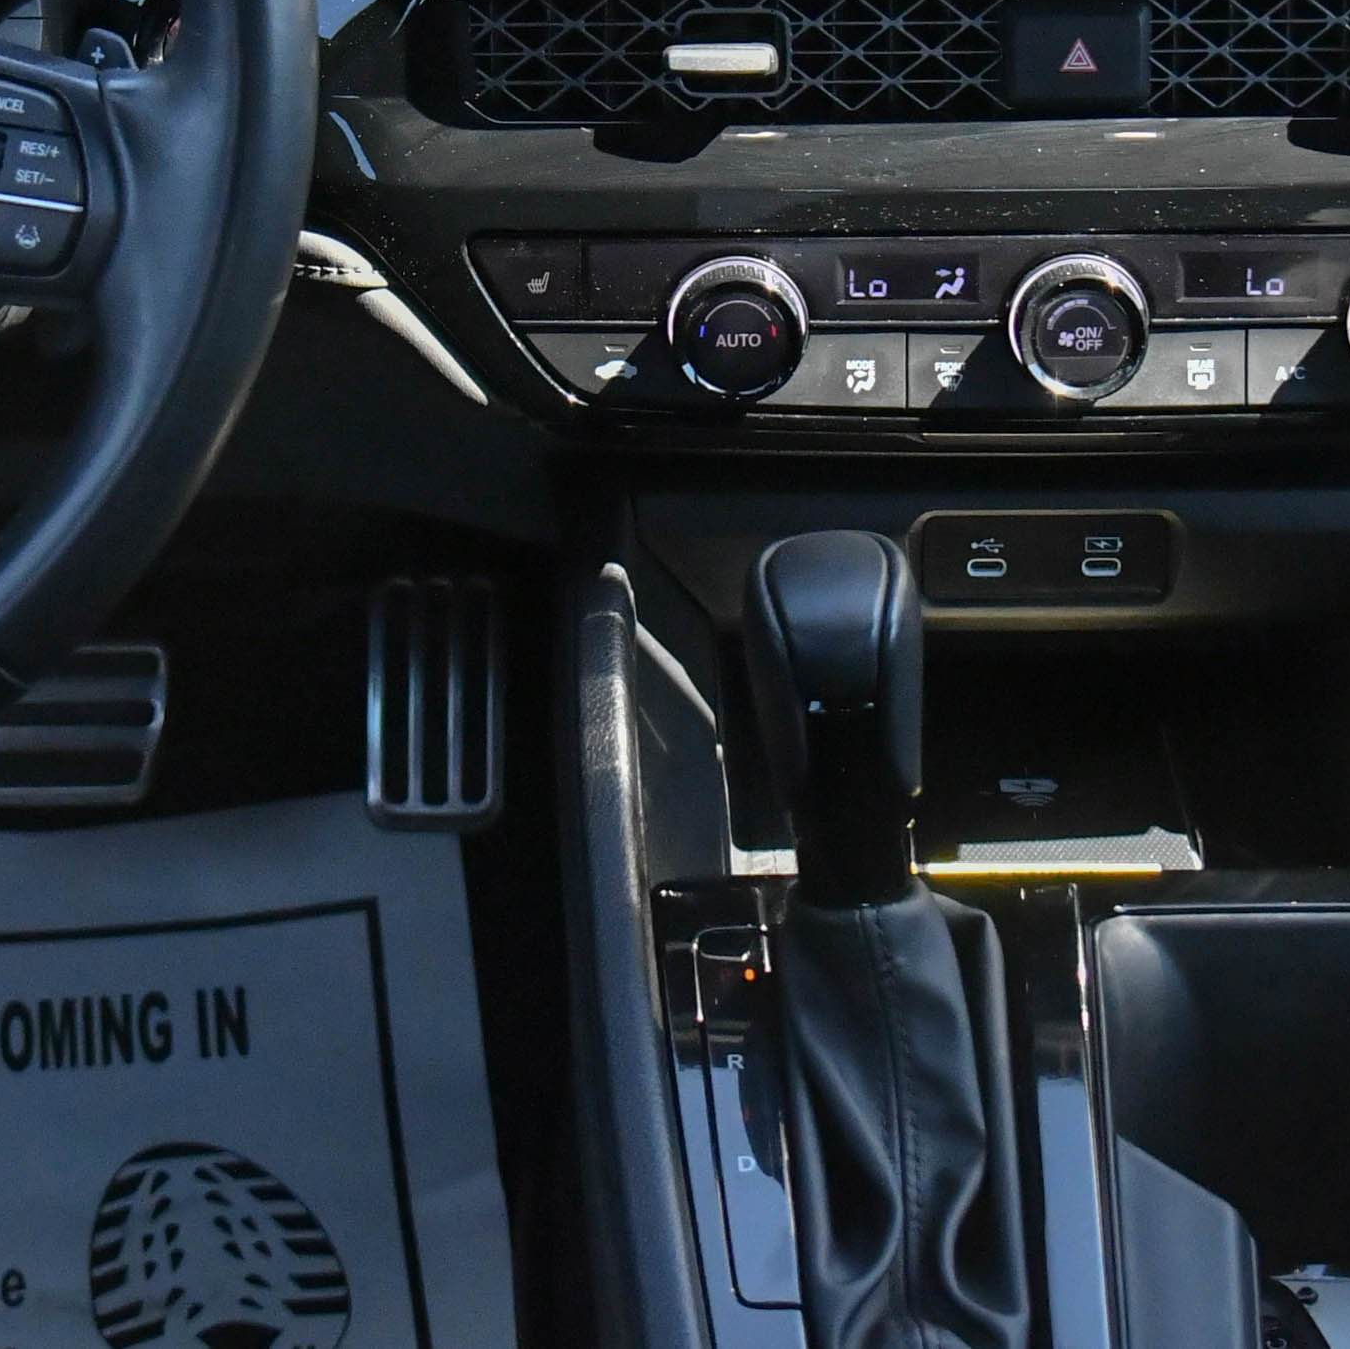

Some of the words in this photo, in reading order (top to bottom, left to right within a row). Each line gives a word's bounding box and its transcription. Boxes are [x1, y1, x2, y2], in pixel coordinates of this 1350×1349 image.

[715, 332, 762, 348] AUTO
[1075, 326, 1104, 339] ON/
[1075, 339, 1104, 351] OFF
[846, 359, 876, 371] MODE
[934, 361, 966, 372] FRONT
[1274, 365, 1308, 382] A/C
[195, 986, 251, 1060] IN
[726, 1053, 745, 1071] R
[737, 1155, 757, 1173] D
